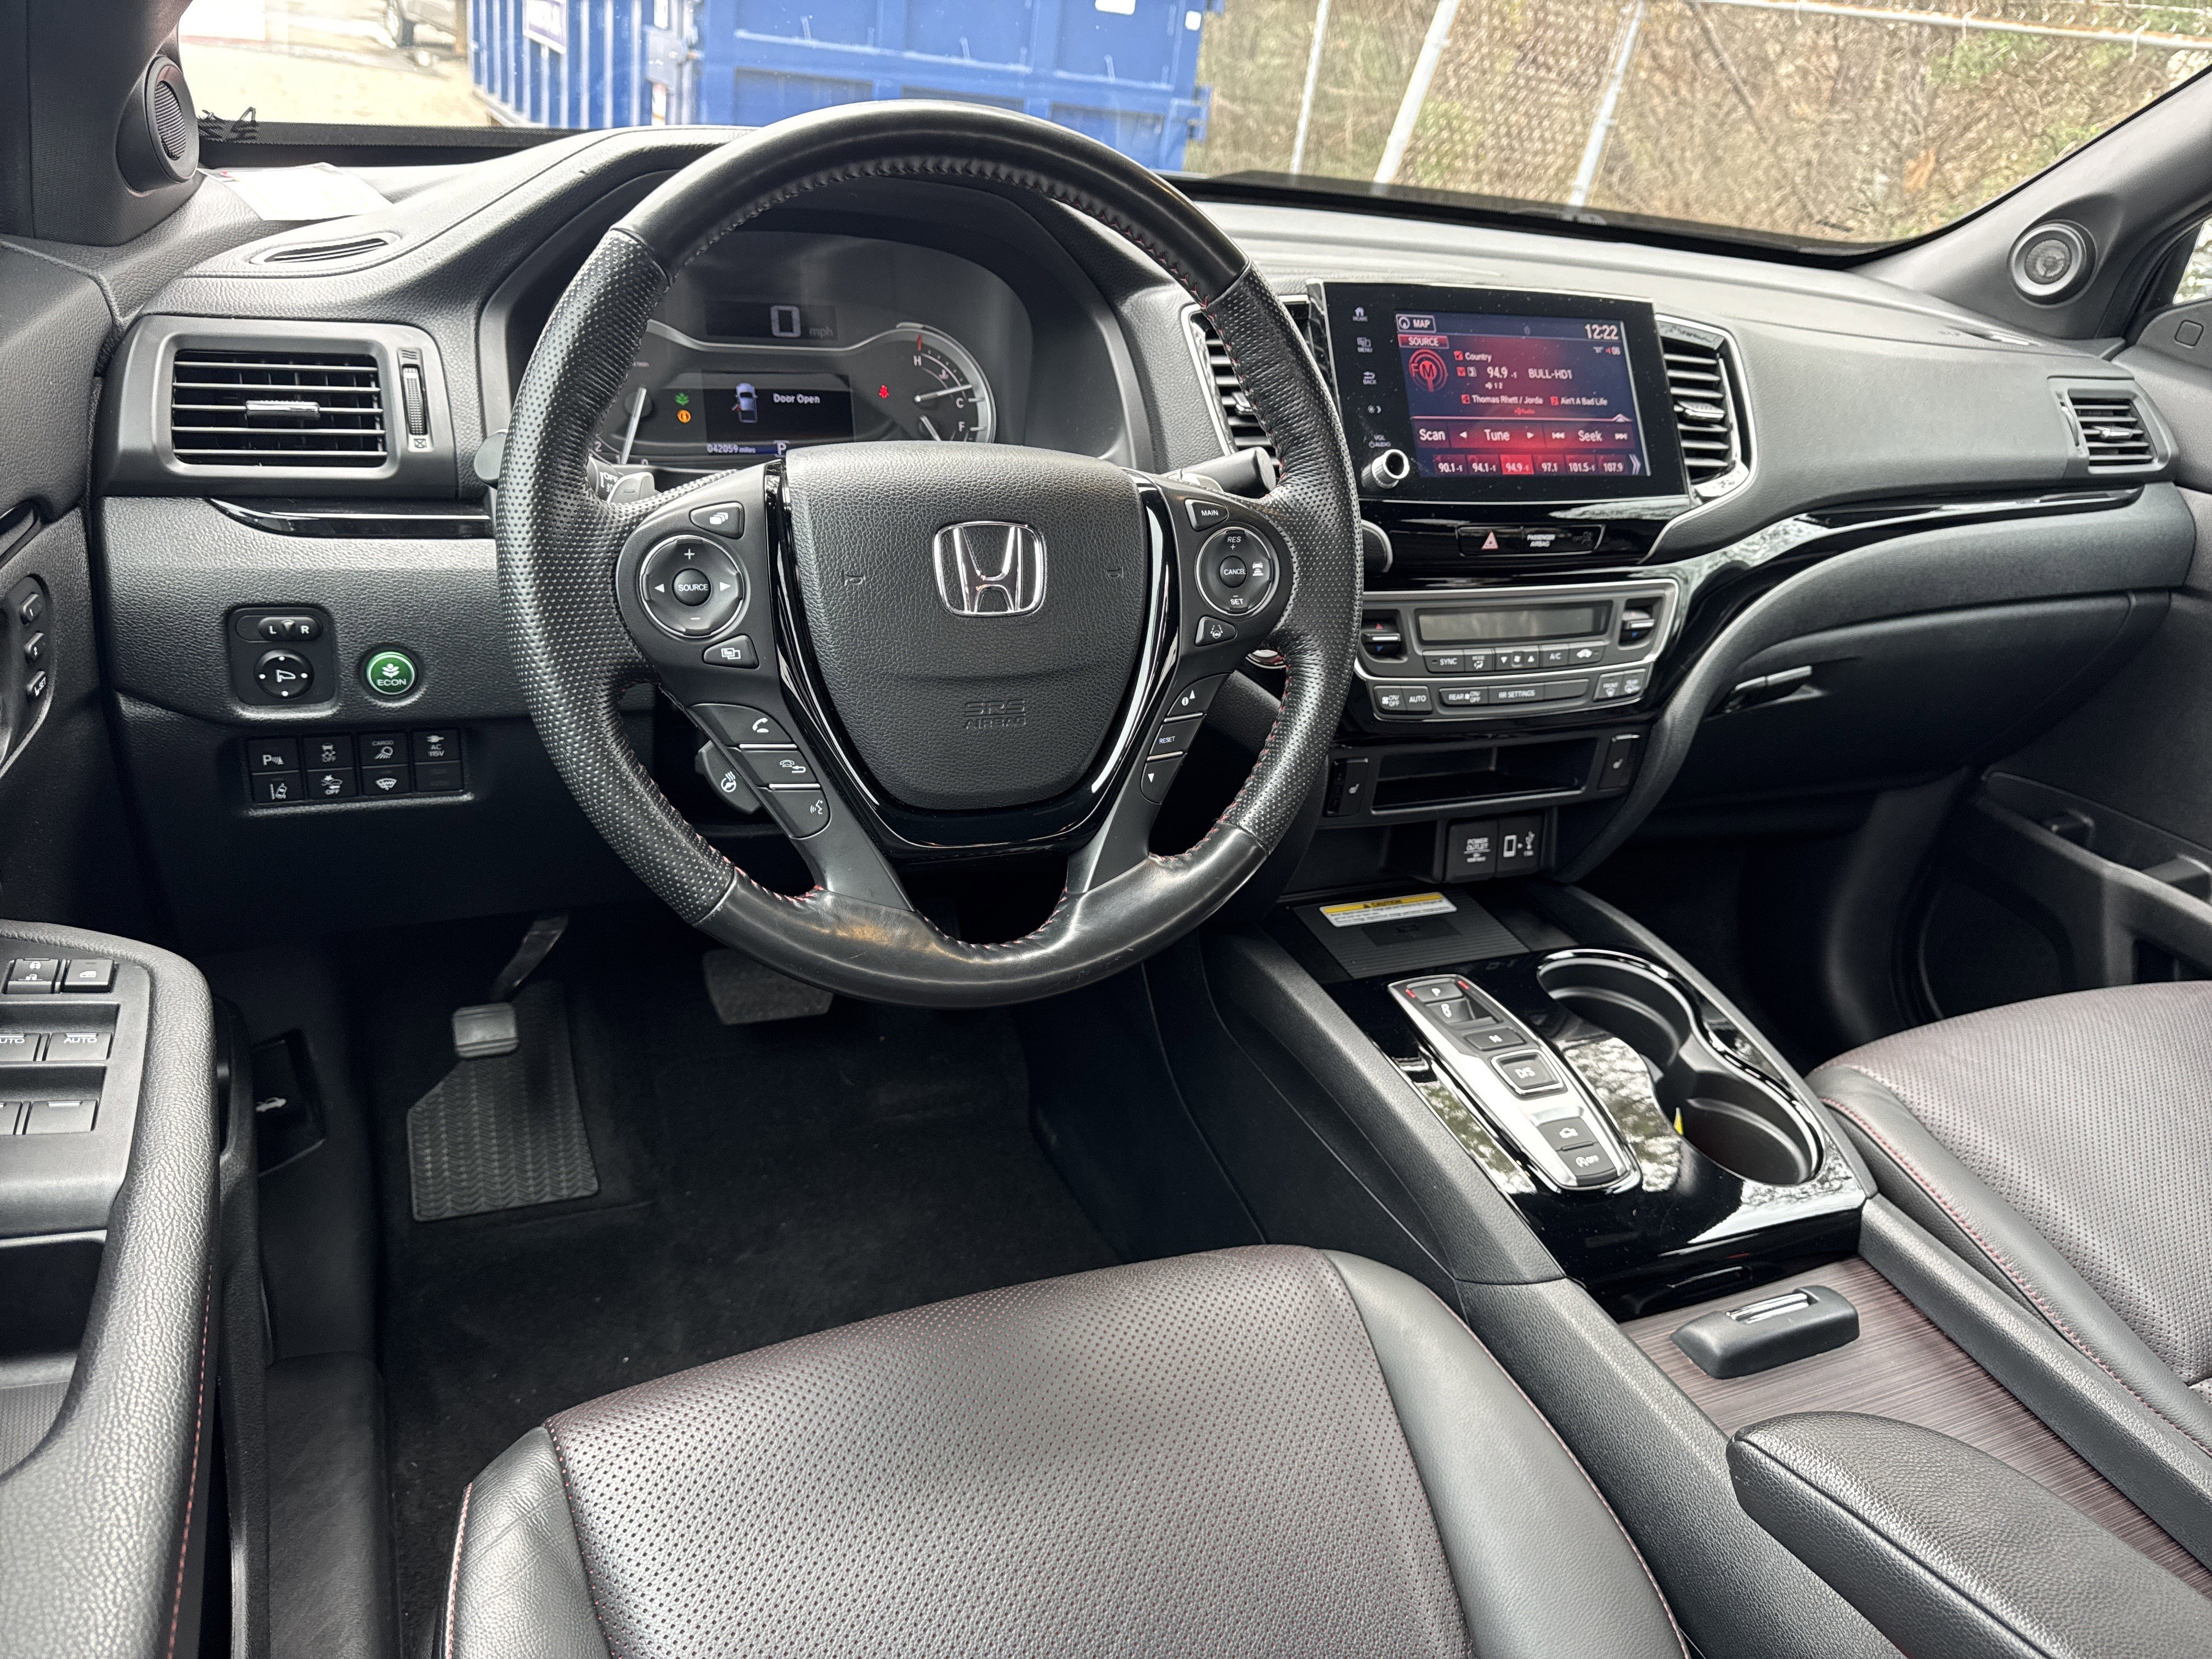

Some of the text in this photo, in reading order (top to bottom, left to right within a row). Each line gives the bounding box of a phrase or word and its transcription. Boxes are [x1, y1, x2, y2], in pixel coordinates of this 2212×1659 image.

[770, 305, 802, 337] 0
[1413, 319, 1431, 329] MAP
[1585, 324, 1619, 340] 12:22
[1408, 336, 1440, 347] SOURCE
[913, 355, 922, 366] H
[1464, 352, 1493, 363] Country
[1486, 366, 1509, 379] 94.9
[1528, 368, 1573, 380] BULL-HD1
[772, 393, 821, 404] Door Open
[956, 398, 964, 408] C
[1471, 394, 1500, 404] Thomas
[958, 421, 966, 432] F
[1419, 428, 1446, 441] Scan
[1483, 428, 1510, 442] Tune
[1578, 430, 1602, 442] Seek
[706, 442, 738, 454] 042059
[777, 442, 787, 456] P
[678, 583, 709, 591] SOURCE
[269, 625, 277, 635] L
[300, 625, 309, 635] R
[1439, 657, 1458, 666] SYNC
[376, 678, 407, 686] ECON
[1409, 695, 1426, 703] AUTO
[1508, 690, 1536, 698] SETTINGS
[964, 698, 1026, 715] SRS
[1159, 736, 1176, 744] RESET
[1488, 1035, 1502, 1043] N
